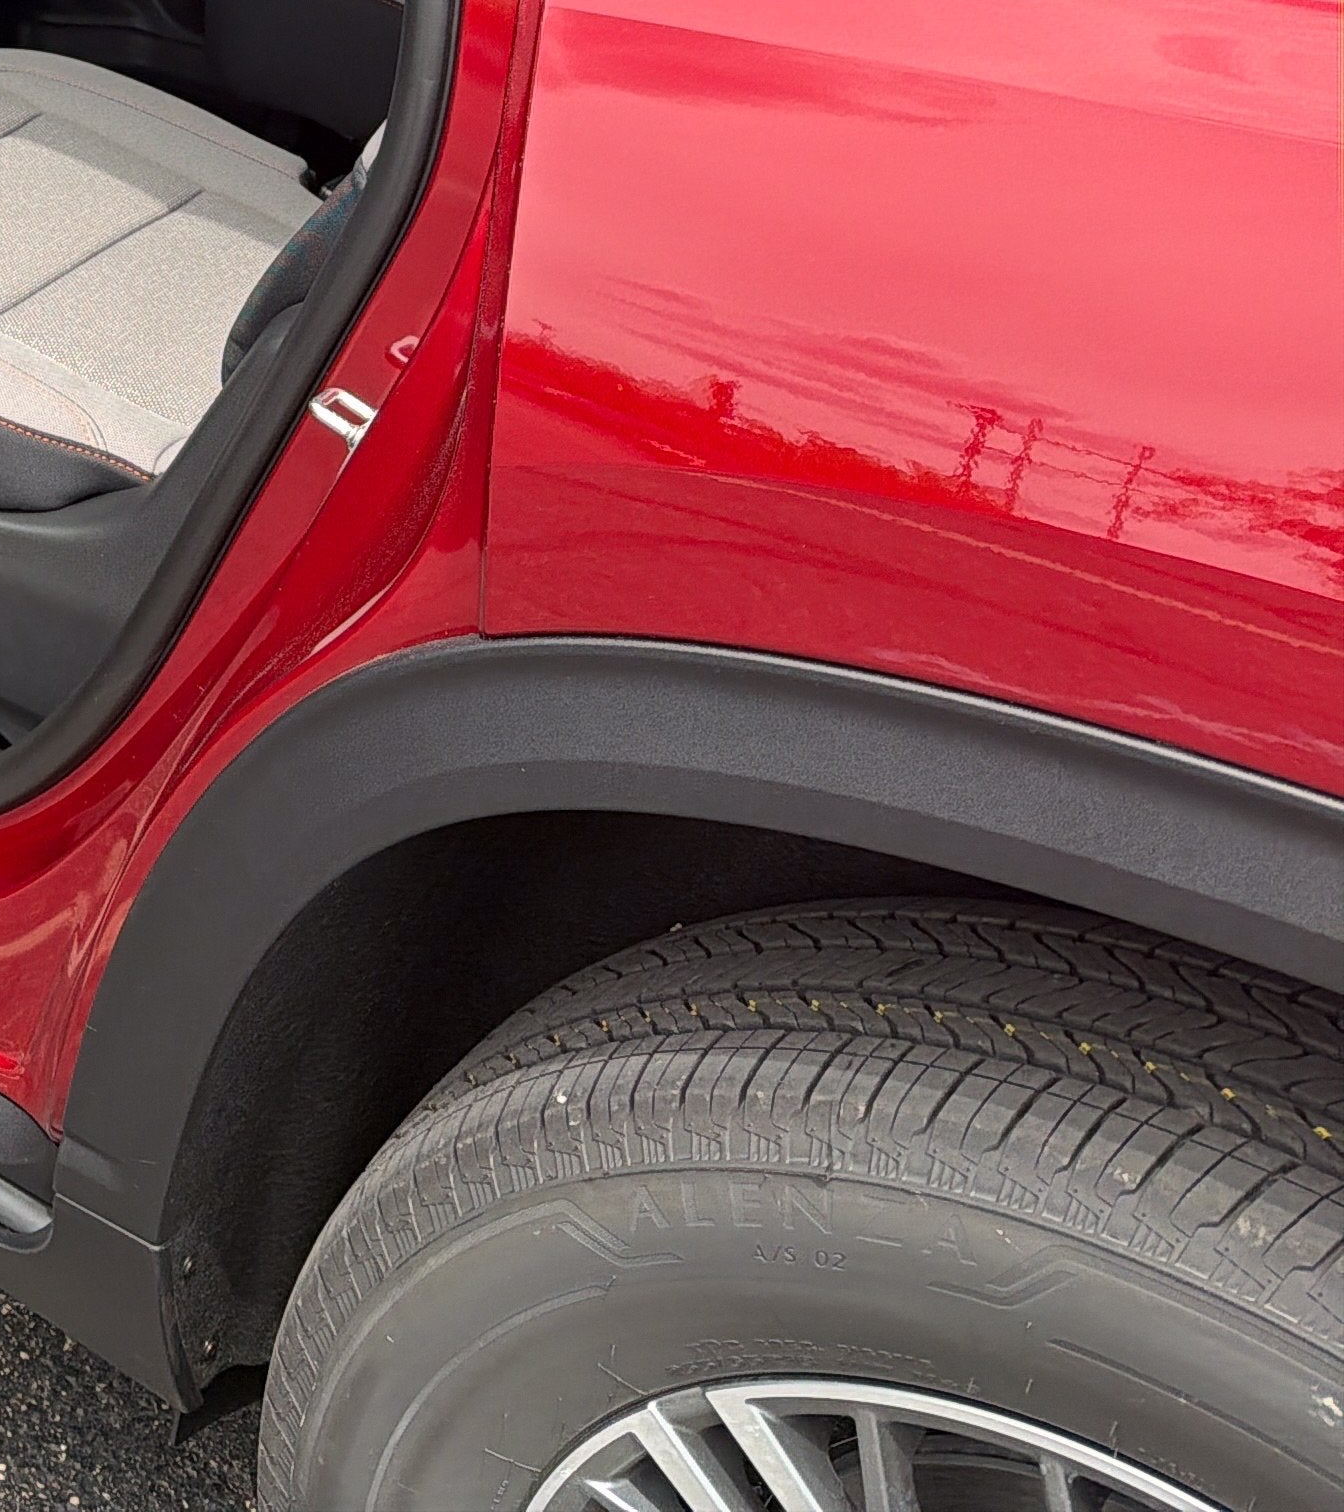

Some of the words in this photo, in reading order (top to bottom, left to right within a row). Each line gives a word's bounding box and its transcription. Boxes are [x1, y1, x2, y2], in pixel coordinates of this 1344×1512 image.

[630, 1179, 978, 1266] ALENZA
[754, 1244, 797, 1264] A/S
[814, 1249, 848, 1271] 02
